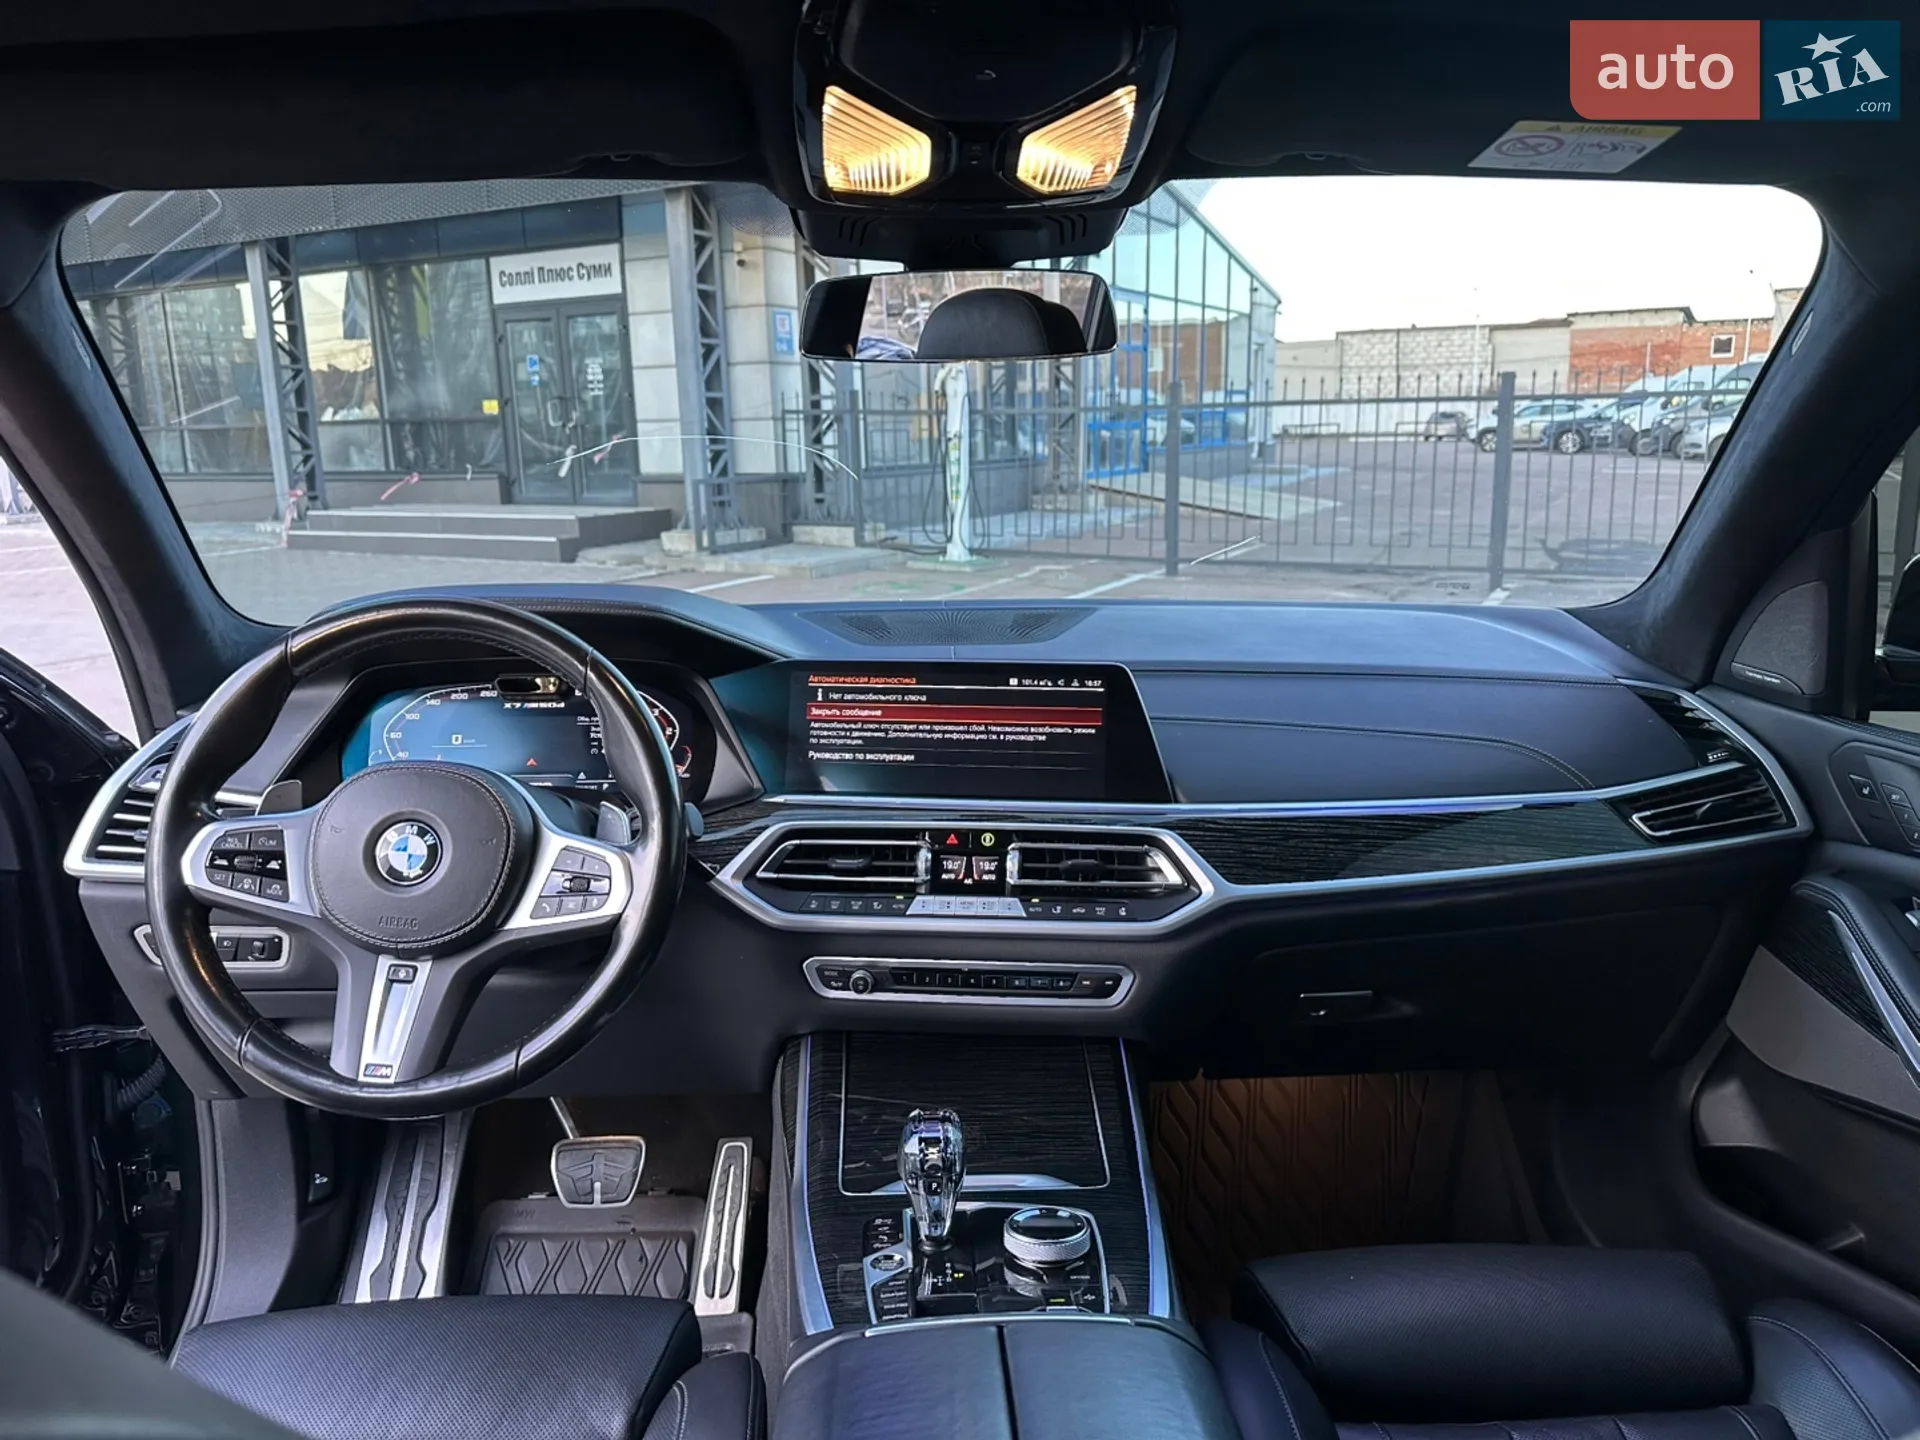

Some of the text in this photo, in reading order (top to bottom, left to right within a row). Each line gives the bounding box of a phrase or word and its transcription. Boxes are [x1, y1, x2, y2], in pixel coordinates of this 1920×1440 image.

[1572, 125, 1645, 136] AIRBAG
[499, 262, 613, 288] Соллі Плюс Суми
[450, 692, 469, 701] 200
[480, 690, 498, 698] 260
[829, 692, 927, 703] Нет автомобильного ключа
[425, 698, 442, 706] 140
[405, 712, 420, 721] 100
[810, 706, 882, 718] Закрыть сообщение
[386, 825, 435, 846] BMW
[378, 916, 419, 930] AIRBAG
